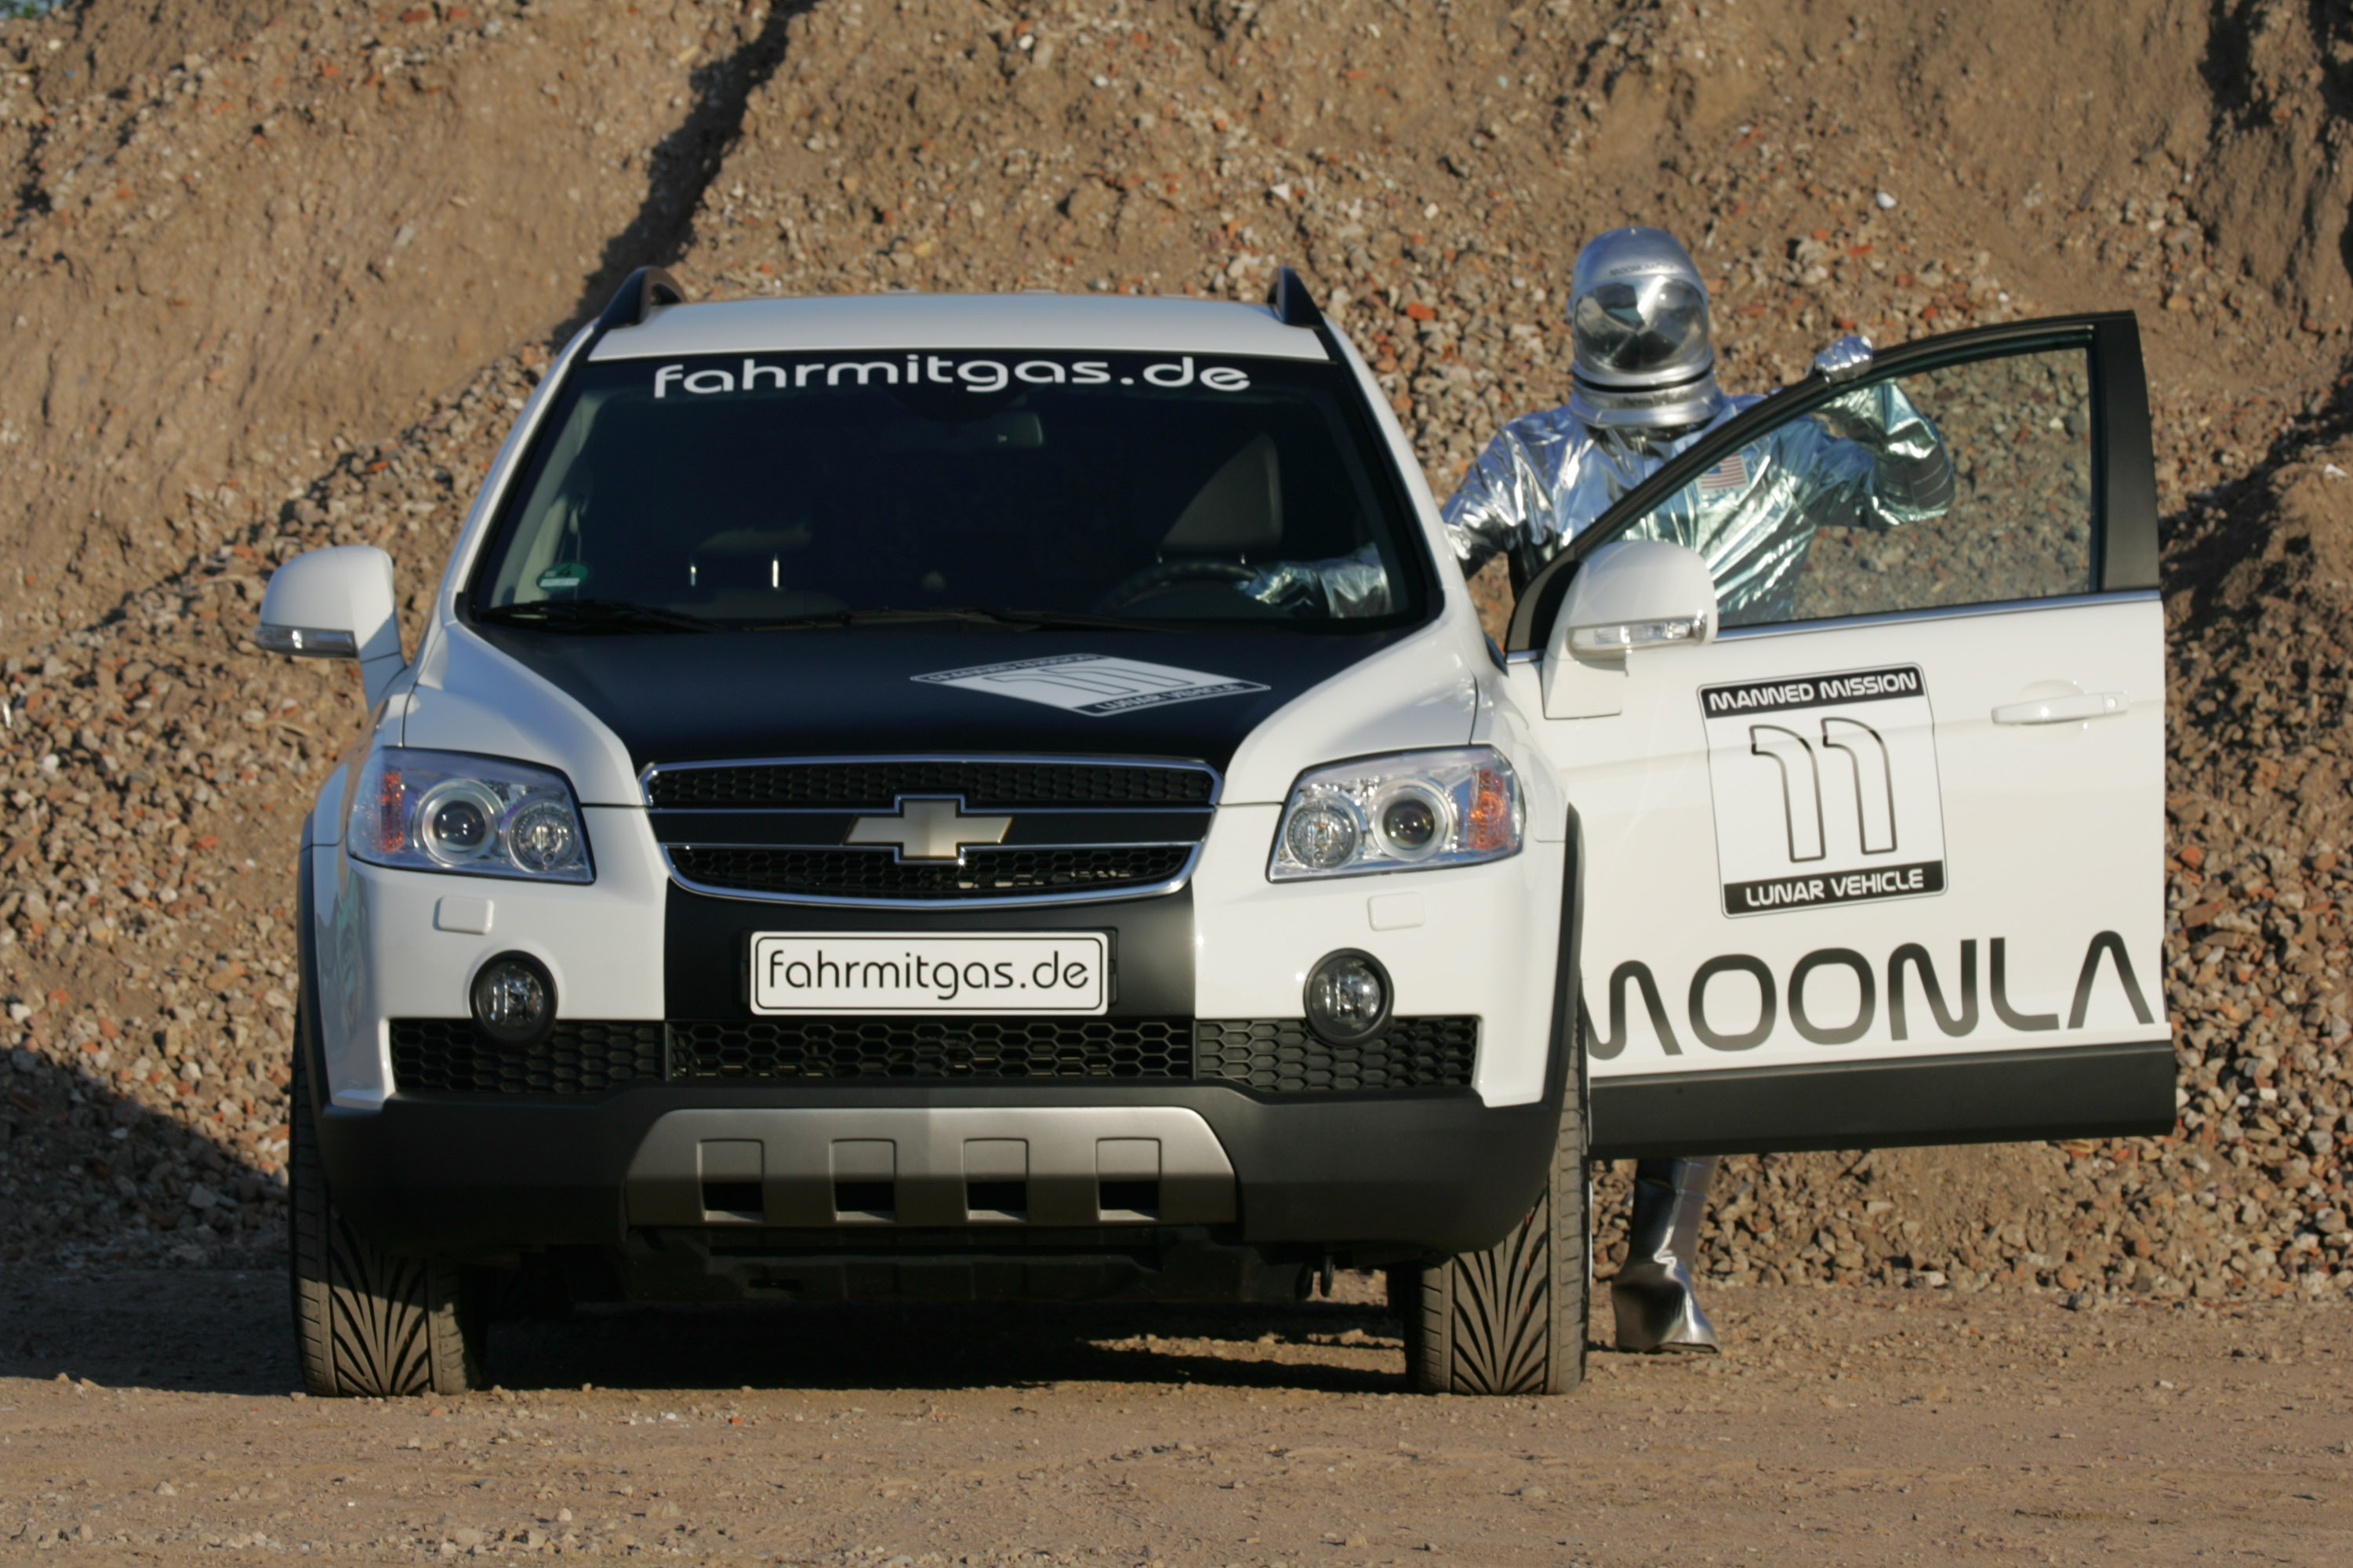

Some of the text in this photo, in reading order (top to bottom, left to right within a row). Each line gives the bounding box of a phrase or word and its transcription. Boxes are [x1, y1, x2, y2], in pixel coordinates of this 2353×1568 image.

[654, 354, 1251, 398] fahrmitgas.de
[1708, 672, 1918, 711] MANNED MISSION
[1748, 717, 1898, 863] 11
[1745, 868, 1924, 907] LUNAR VEHICLE
[768, 949, 1089, 1000] fahrmitgas.de
[1581, 931, 2170, 1061] MOONLA
